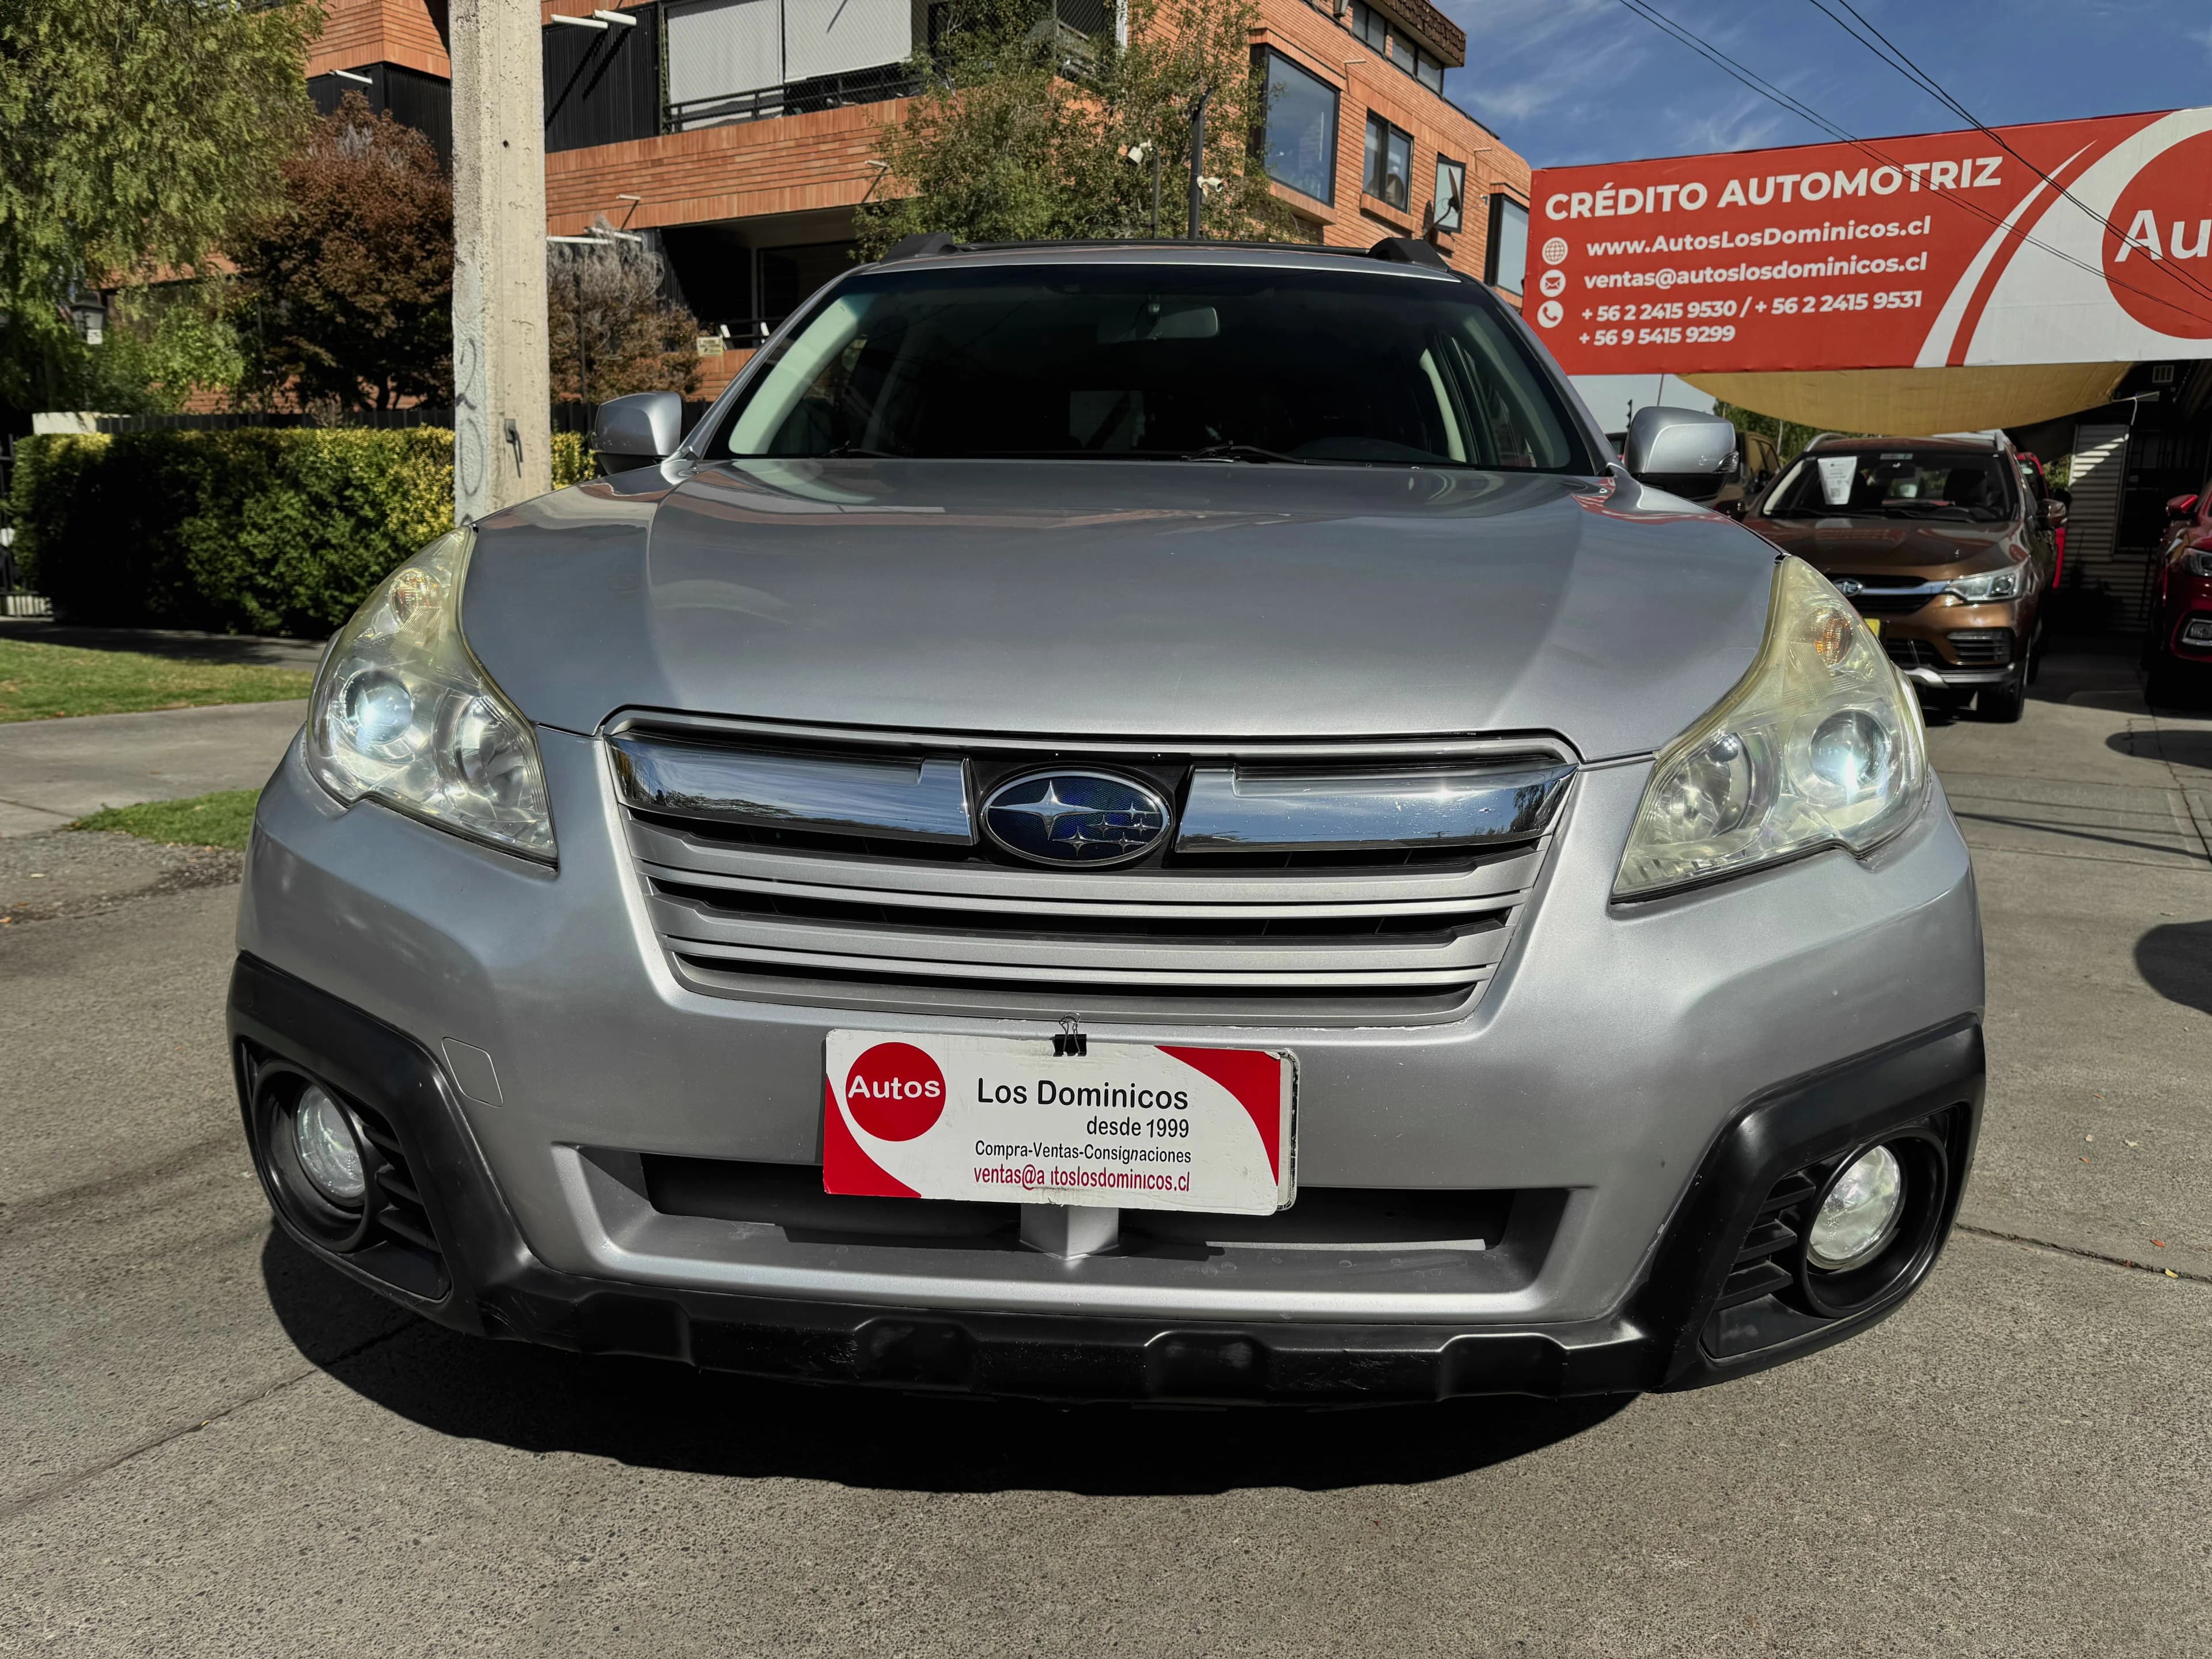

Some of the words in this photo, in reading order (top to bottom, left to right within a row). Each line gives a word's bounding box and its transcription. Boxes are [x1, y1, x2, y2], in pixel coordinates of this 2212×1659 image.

[1545, 182, 1708, 220] CRÉDITO
[1717, 156, 2003, 208] AUTOMOTRIZ
[1586, 215, 1931, 256] www.AutosLosDominicos.cl
[1584, 251, 1927, 290] ventas@autoslosdominicos.cl
[1582, 309, 1593, 320] +
[1596, 305, 1620, 322] 56
[1623, 304, 1637, 321] 2
[1639, 302, 1683, 320] 2415
[1687, 300, 1737, 319] 9530
[1739, 296, 1753, 319] /
[1755, 301, 1767, 313] +
[1771, 297, 1798, 315] 56
[1801, 296, 1816, 313] 2
[1819, 293, 1869, 312] 2415
[1873, 290, 1922, 309] 9531
[1579, 332, 1590, 344] +
[1593, 329, 1618, 346] 56
[1621, 329, 1635, 345] 9
[1638, 326, 1682, 344] 5415
[1685, 325, 1736, 343] 9299
[848, 1075, 941, 1100] Autos
[978, 1077, 1027, 1104] Los
[1037, 1080, 1188, 1110] Dominicos
[1086, 1115, 1141, 1137] desde
[1146, 1118, 1189, 1138] 1999
[975, 1140, 1191, 1165] Compra-Ventas-Consignaciones
